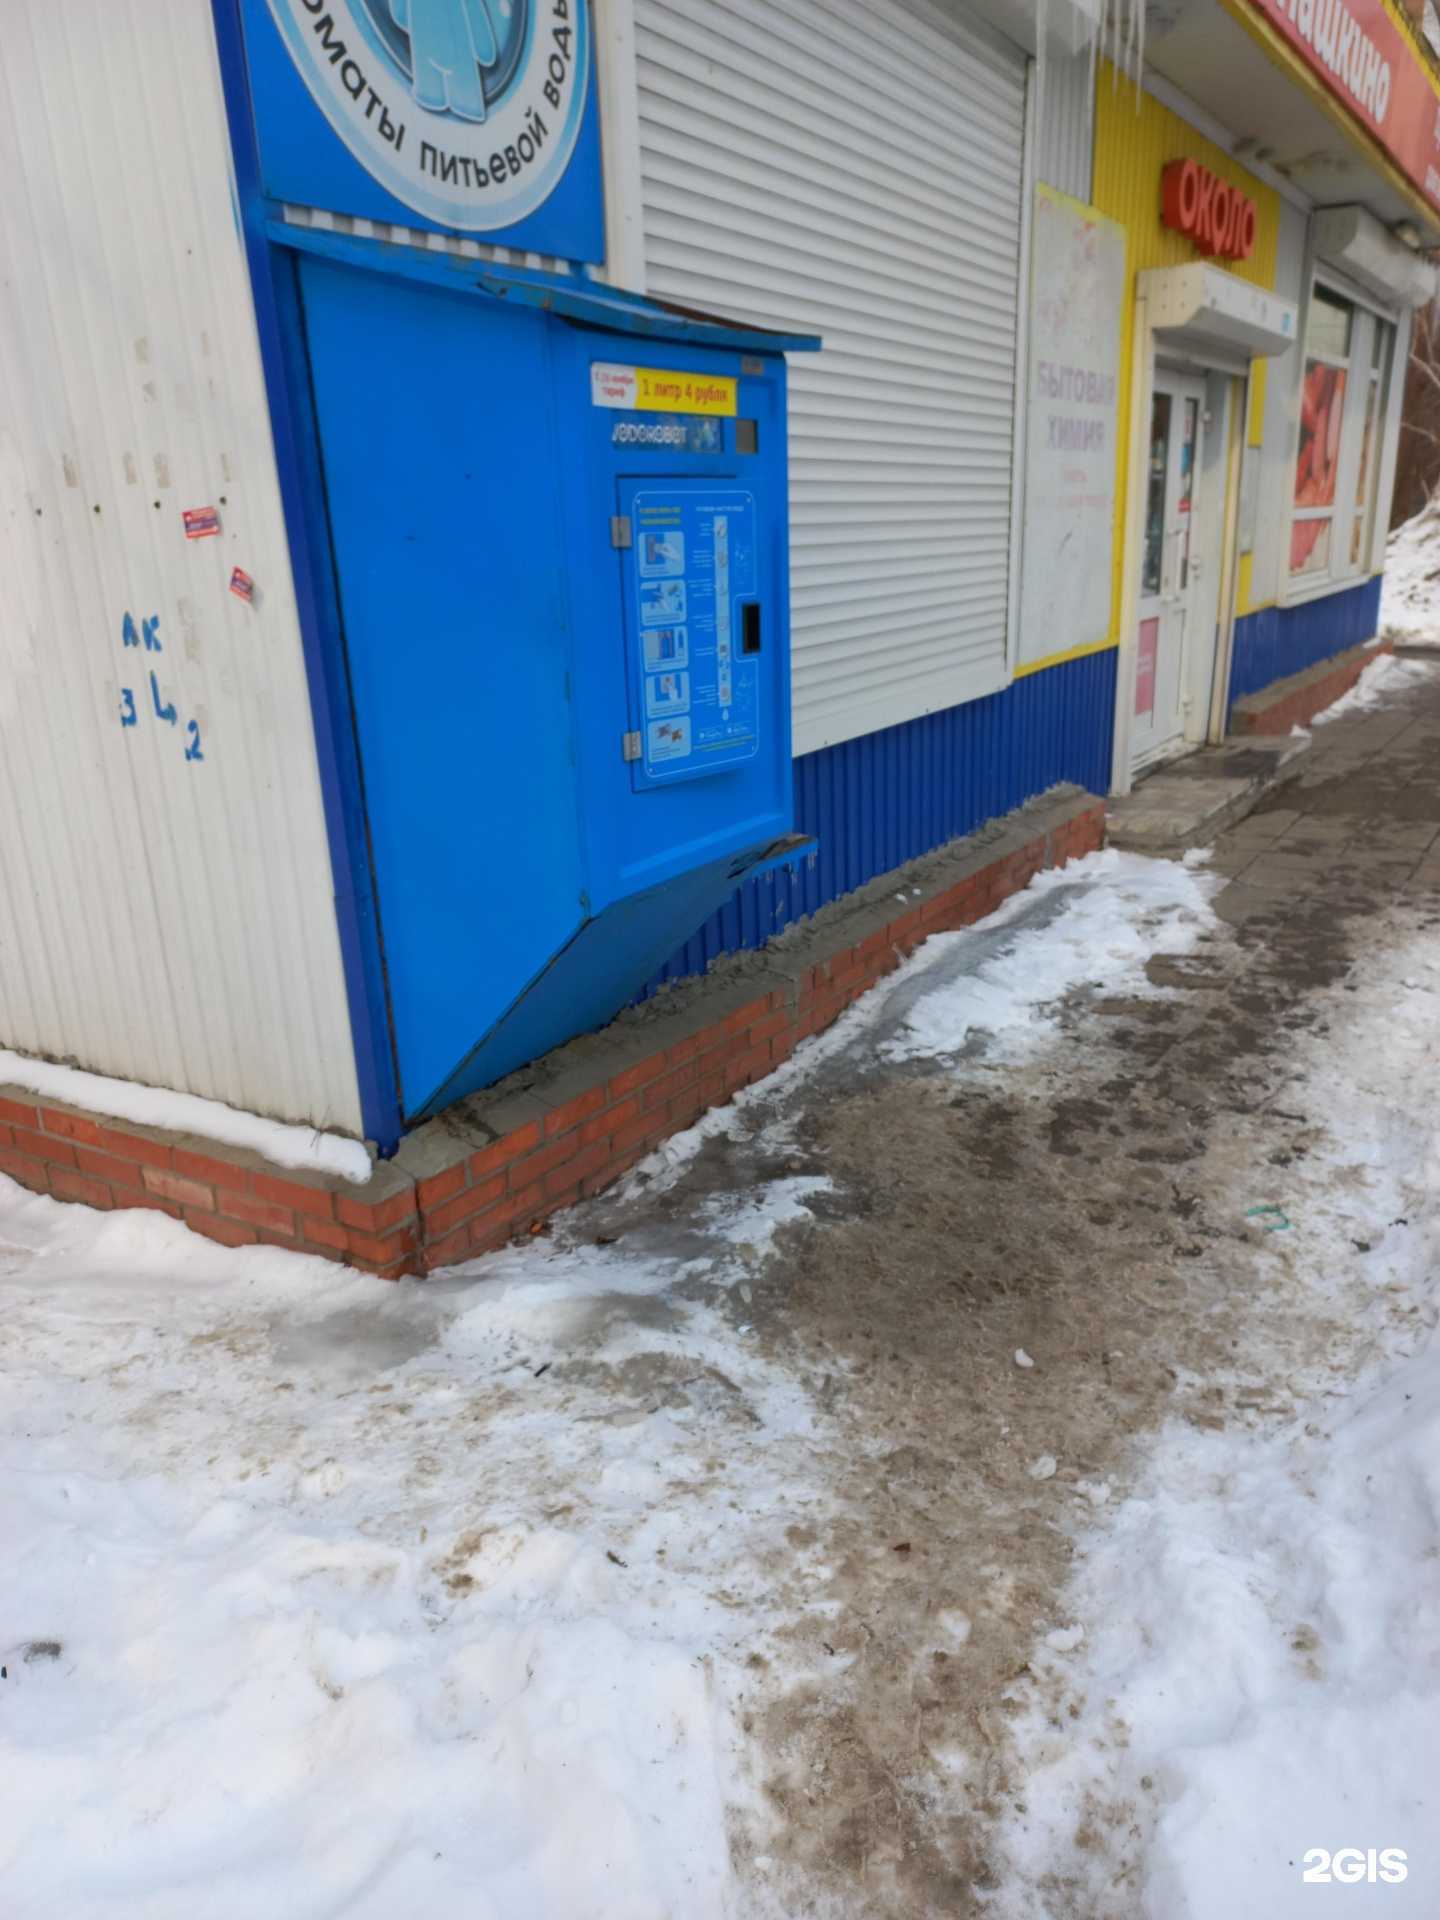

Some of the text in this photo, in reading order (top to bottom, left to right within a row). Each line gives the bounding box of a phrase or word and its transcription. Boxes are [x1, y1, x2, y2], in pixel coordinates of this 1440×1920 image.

[1275, 0, 1390, 124] ашкино
[420, 106, 549, 188] питьевой
[1179, 158, 1257, 258] ОКОЛО
[642, 378, 650, 396] 1
[684, 383, 693, 399] 4
[1048, 414, 1106, 453] ХИМИЯ
